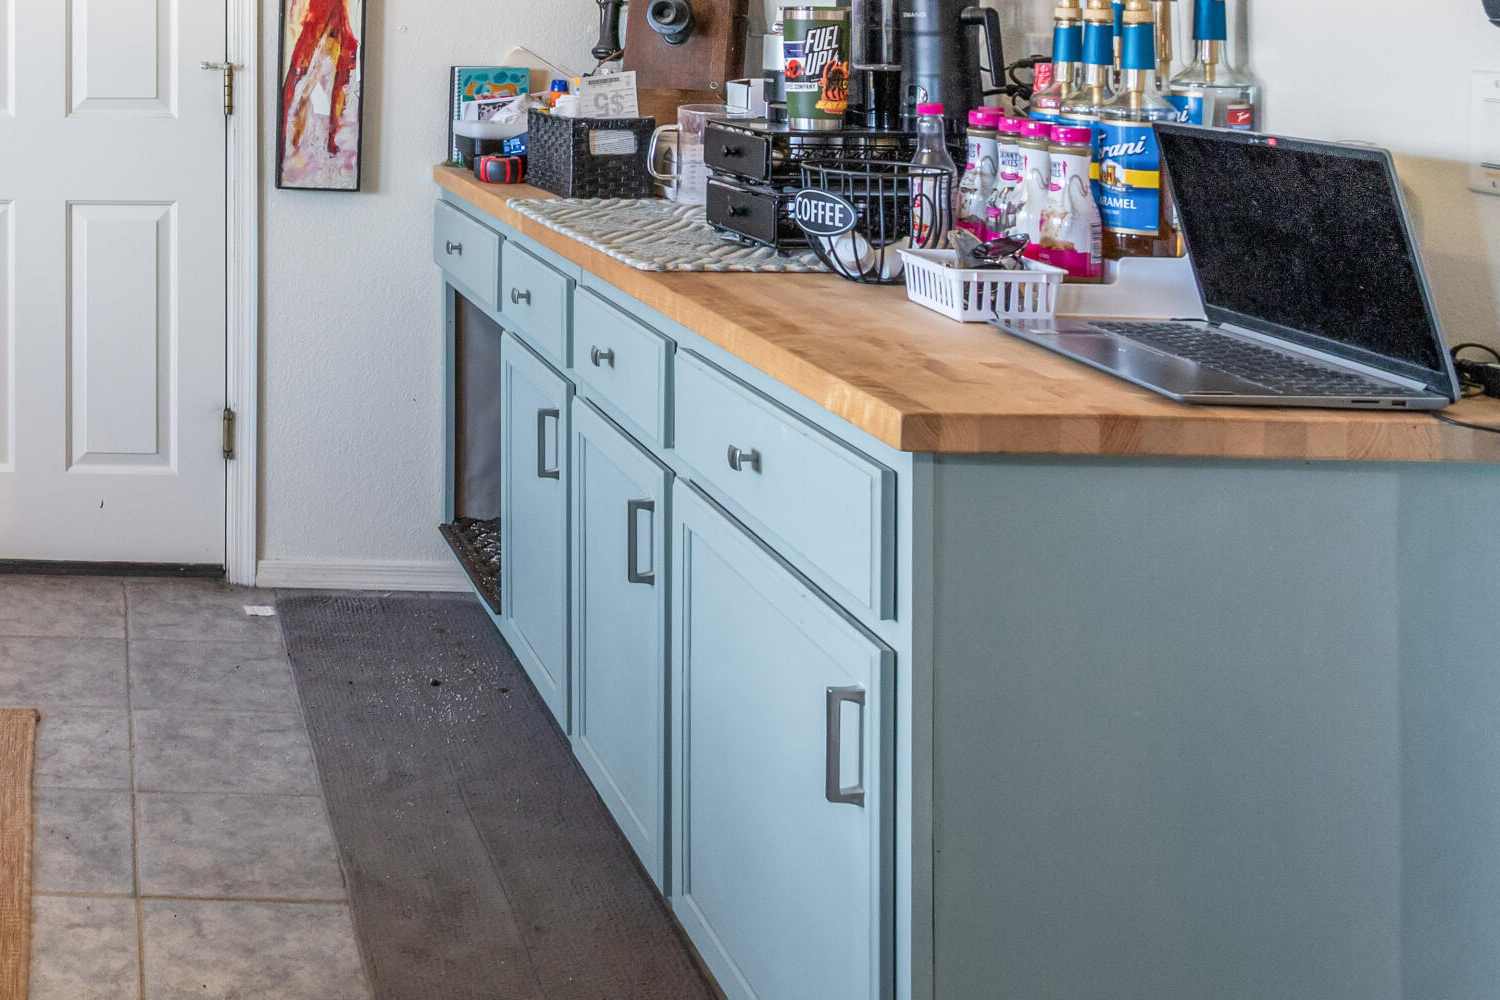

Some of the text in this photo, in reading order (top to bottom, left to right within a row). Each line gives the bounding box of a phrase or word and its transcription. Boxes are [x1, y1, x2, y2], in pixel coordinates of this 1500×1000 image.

[804, 25, 839, 54] FUEL
[593, 91, 624, 116] $5
[796, 197, 844, 227] COFFEE
[1100, 195, 1137, 210] ARAMEL
